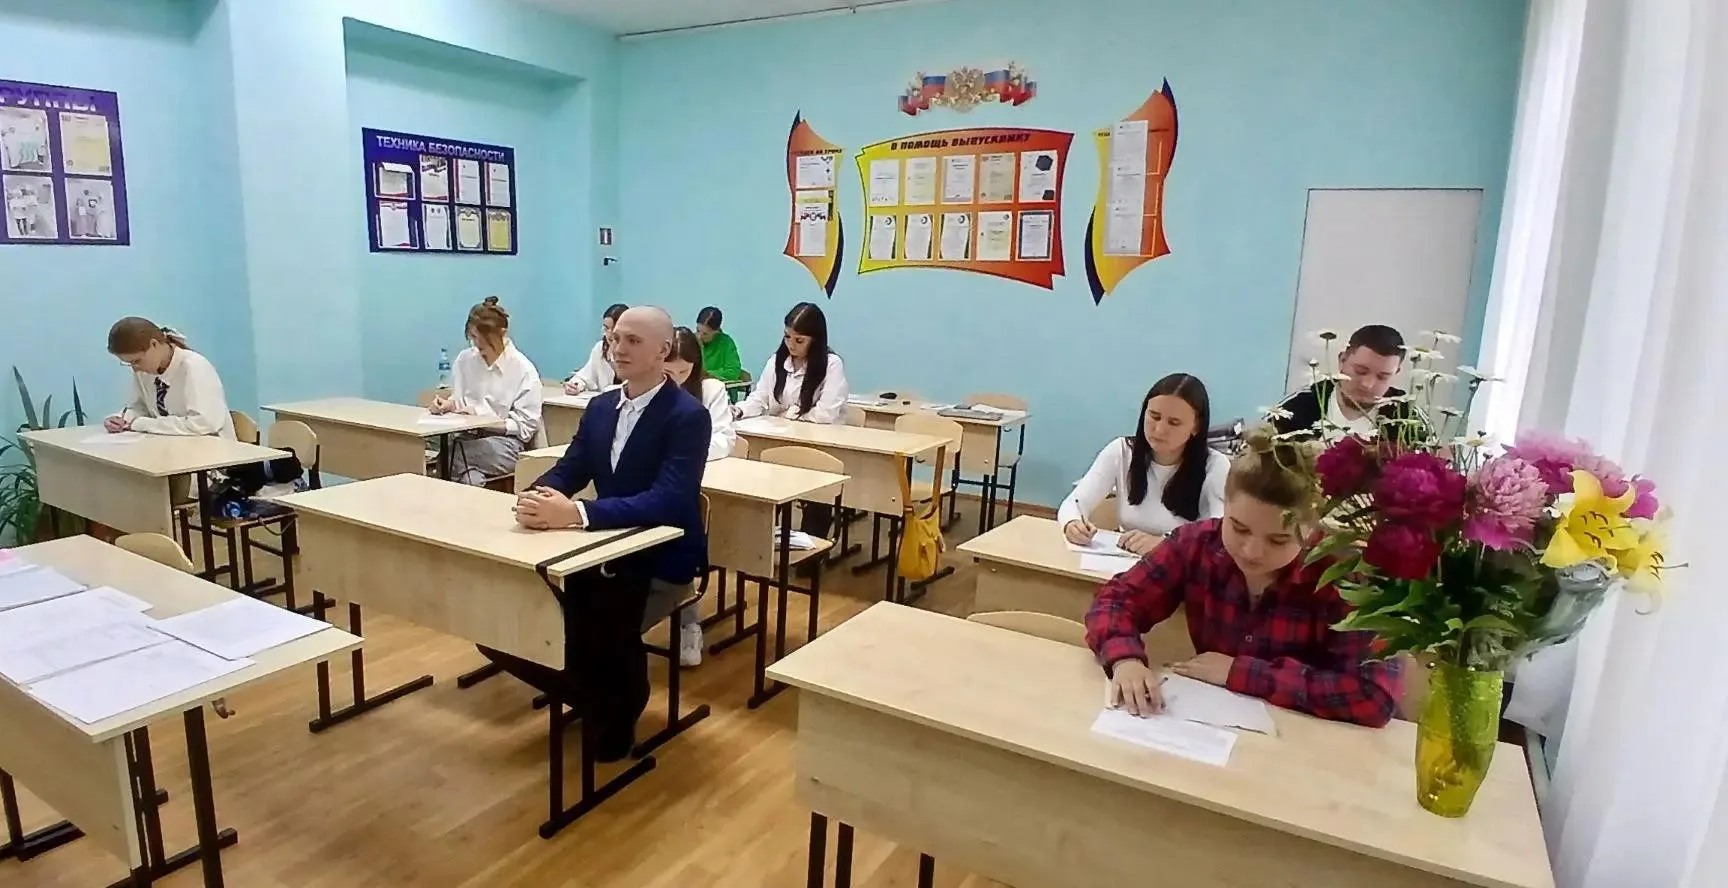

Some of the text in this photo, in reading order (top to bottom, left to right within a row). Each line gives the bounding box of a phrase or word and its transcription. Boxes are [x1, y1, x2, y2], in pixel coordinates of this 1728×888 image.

[376, 135, 505, 161] ТЕХНИКА БЕЗОПАСНОСТИ
[890, 133, 1031, 151] В ПОМОЩЬ ВЫПУСКНИКУ
